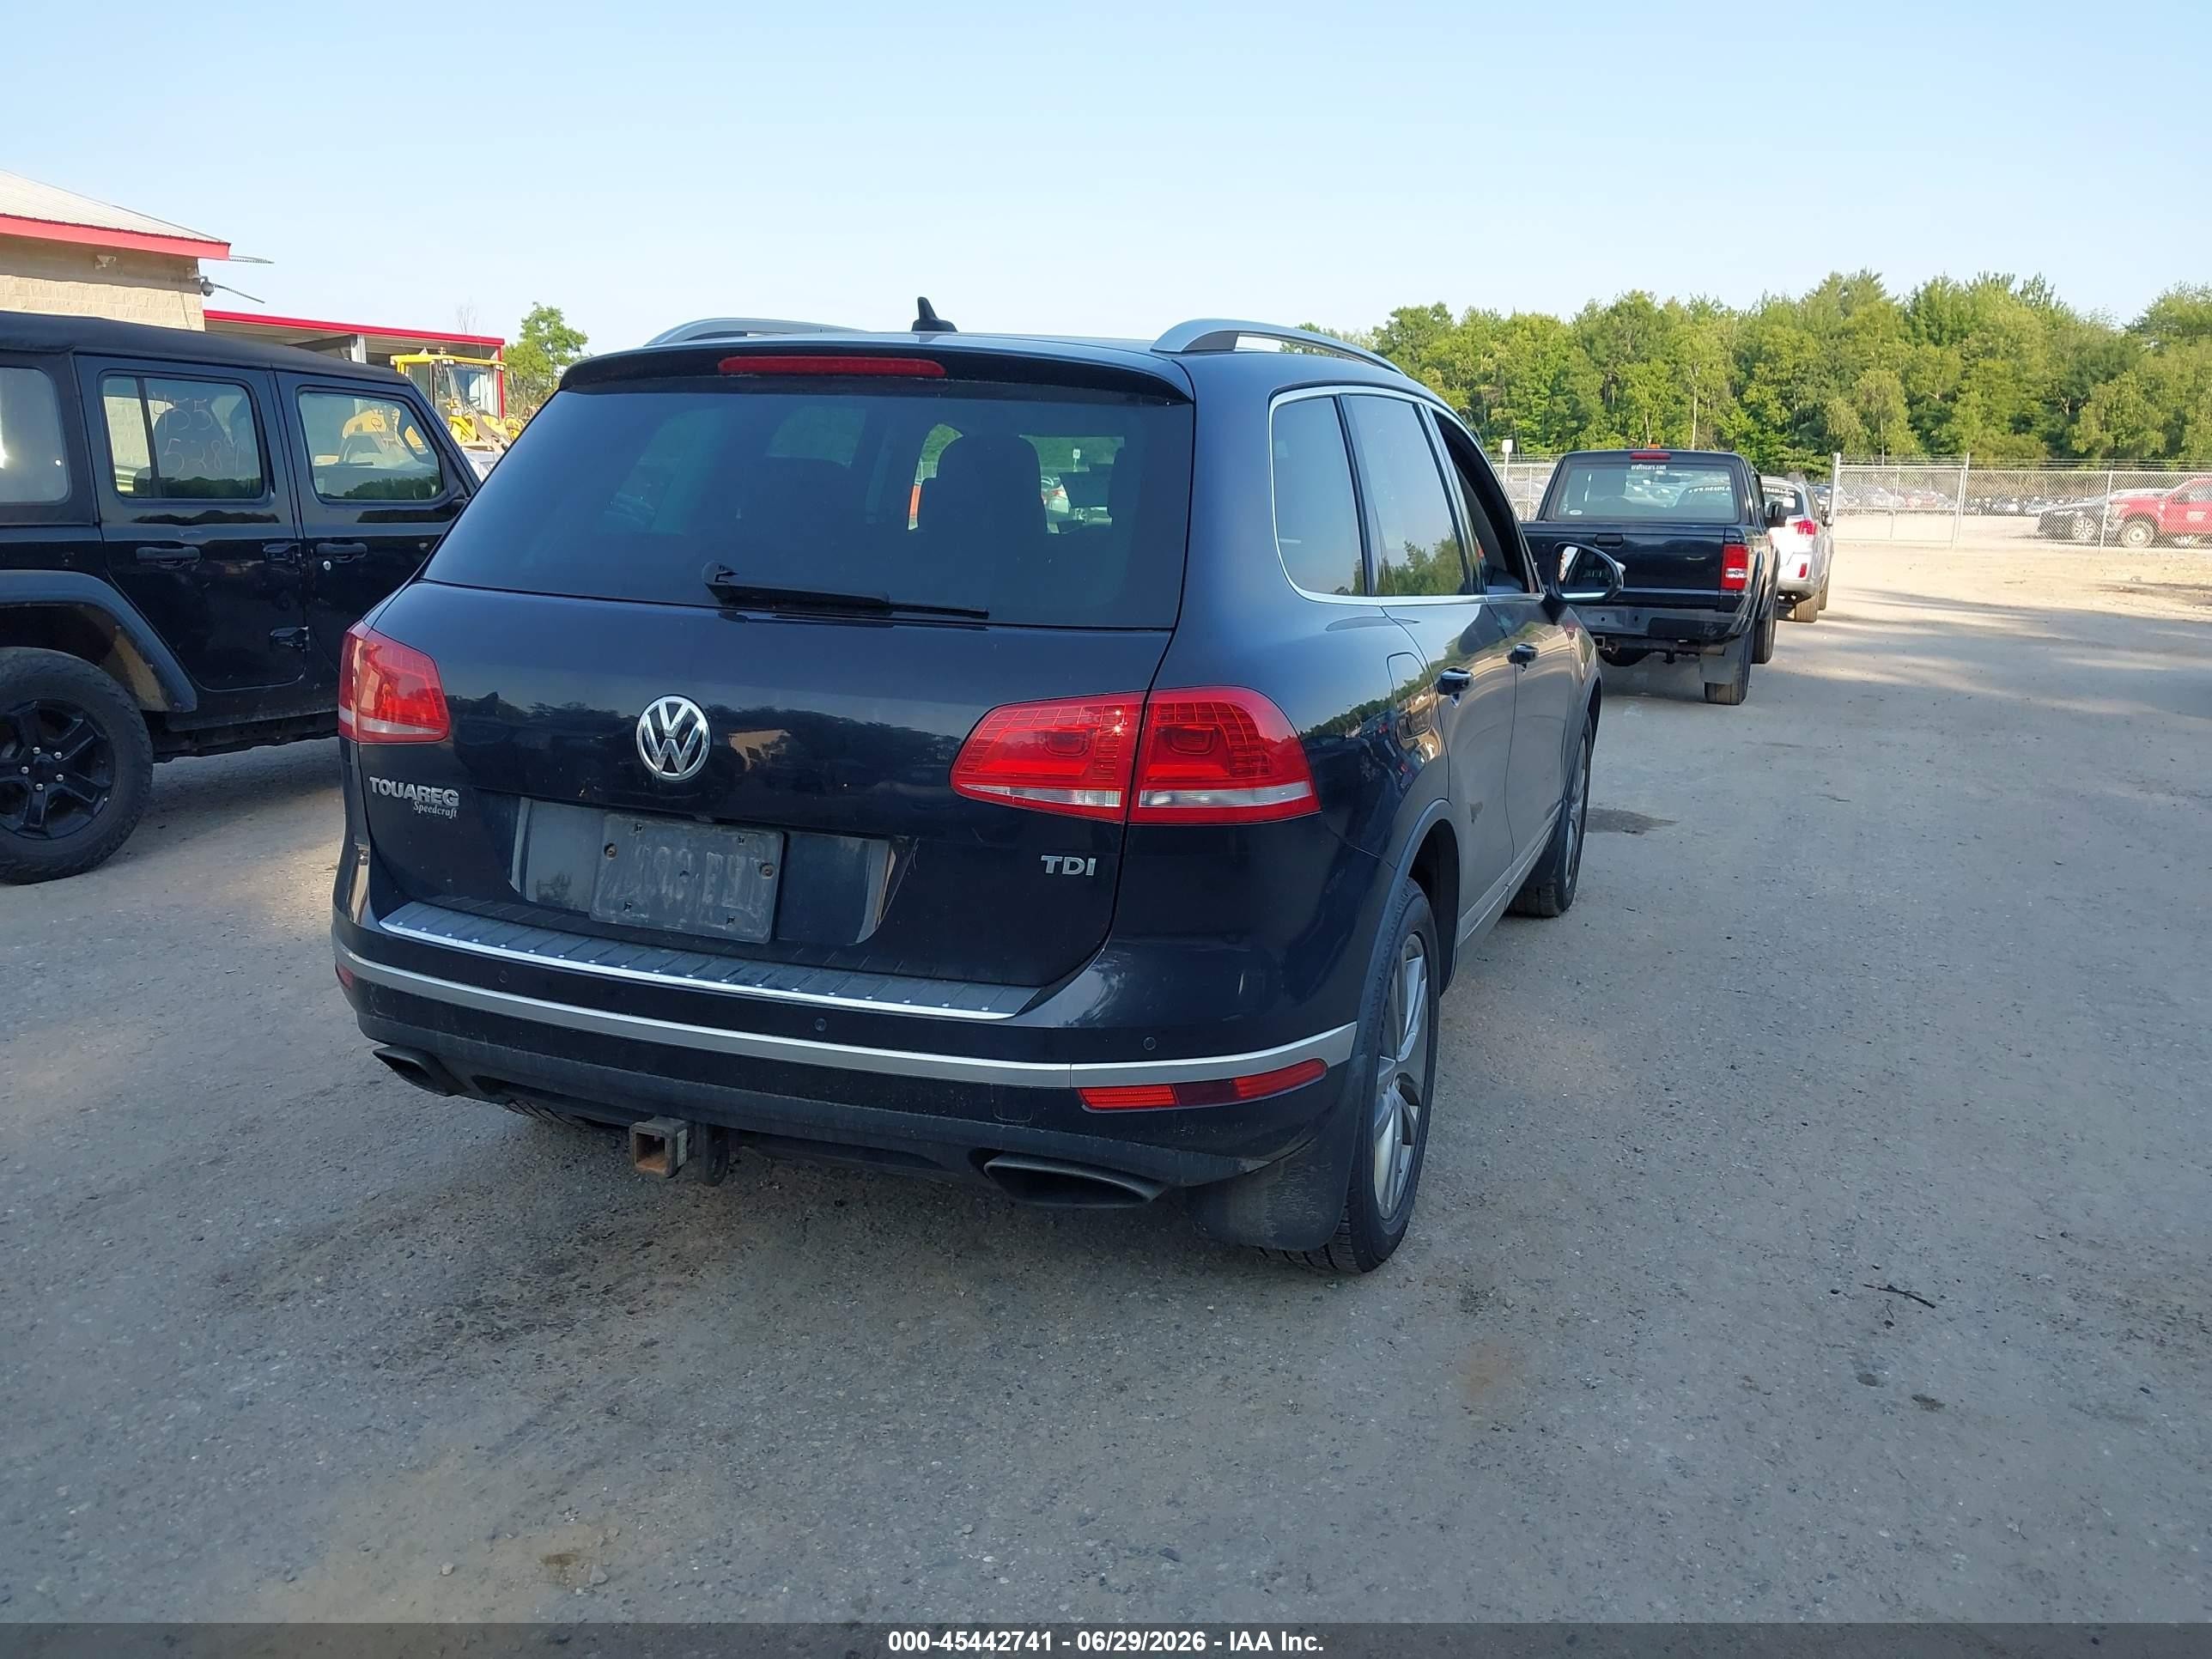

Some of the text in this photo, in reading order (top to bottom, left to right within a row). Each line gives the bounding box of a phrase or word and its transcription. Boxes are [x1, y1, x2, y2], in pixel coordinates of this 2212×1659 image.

[636, 696, 711, 782] VW
[369, 776, 459, 806] TOUAREG
[413, 800, 457, 819] Speedcraft
[1041, 855, 1097, 876] TDI
